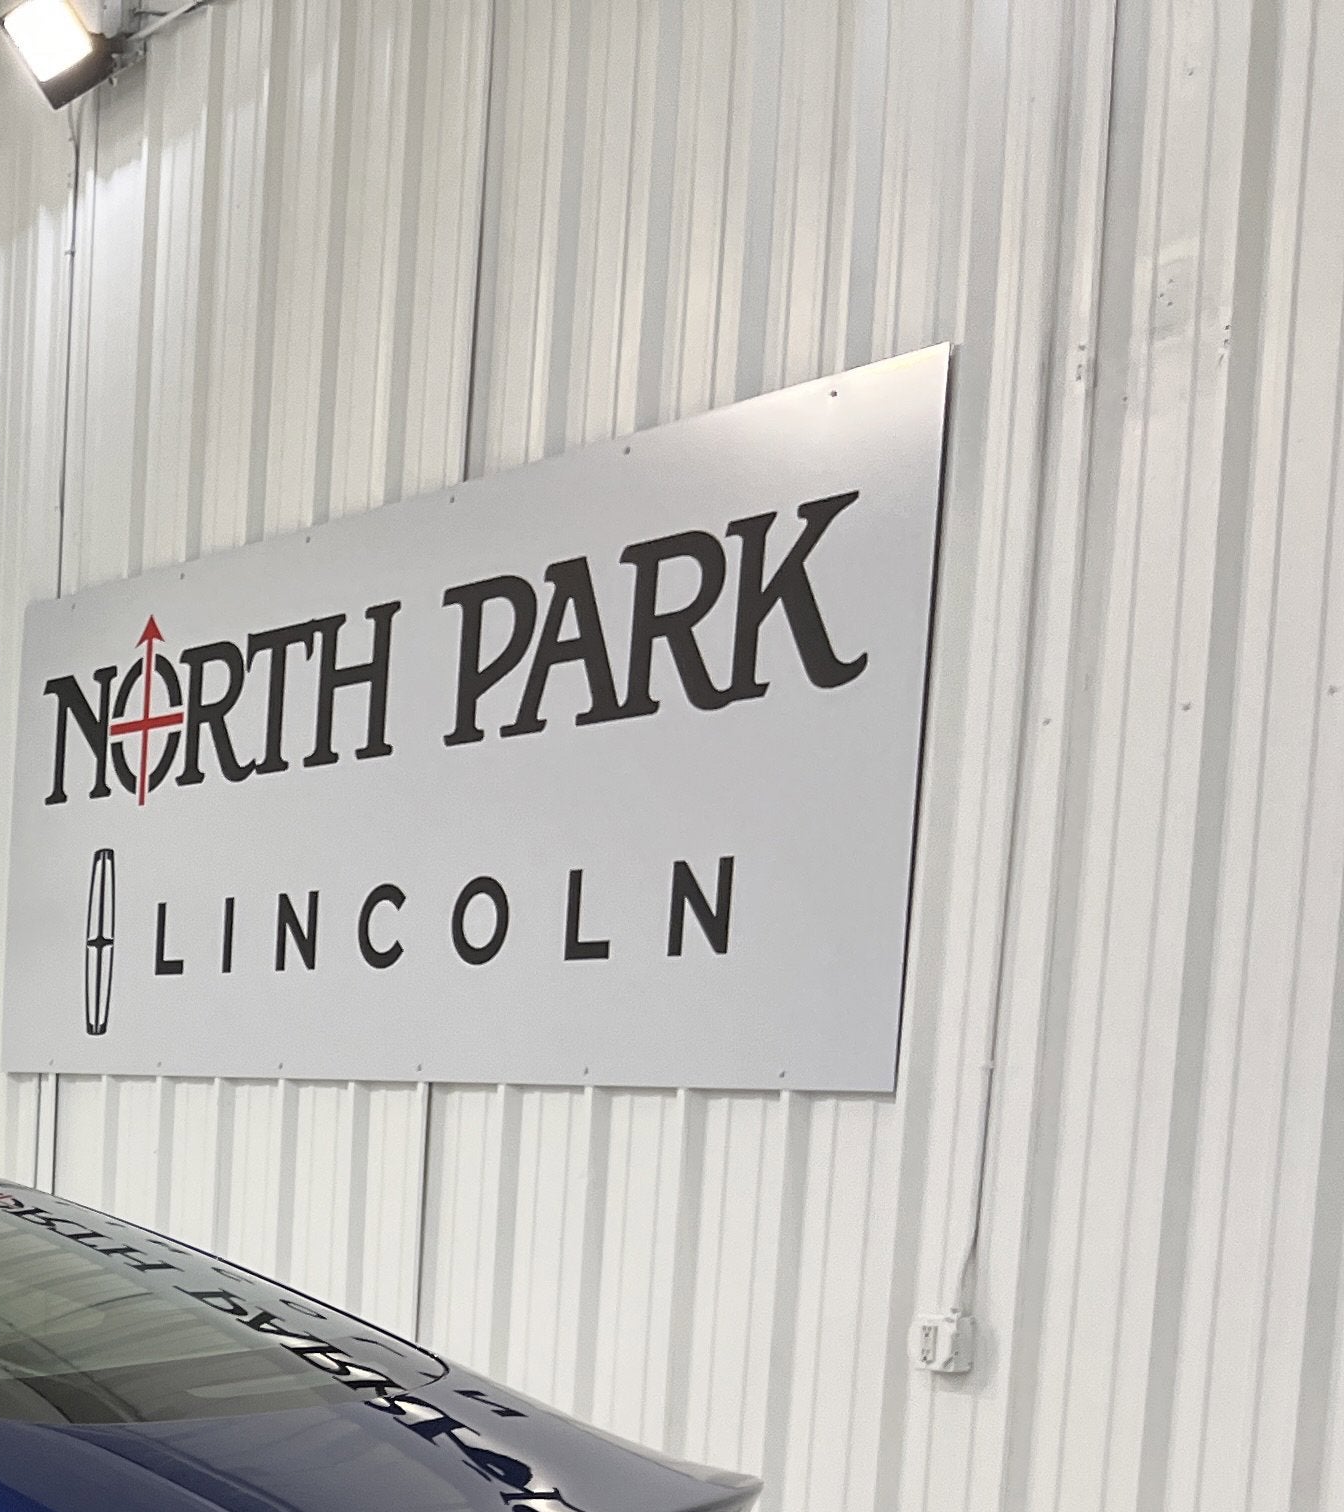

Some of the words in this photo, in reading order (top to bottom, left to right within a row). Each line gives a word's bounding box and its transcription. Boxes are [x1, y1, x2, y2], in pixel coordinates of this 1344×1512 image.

[44, 600, 403, 805] NORTH
[443, 490, 869, 747] PARK
[155, 856, 736, 976] LINCOLN
